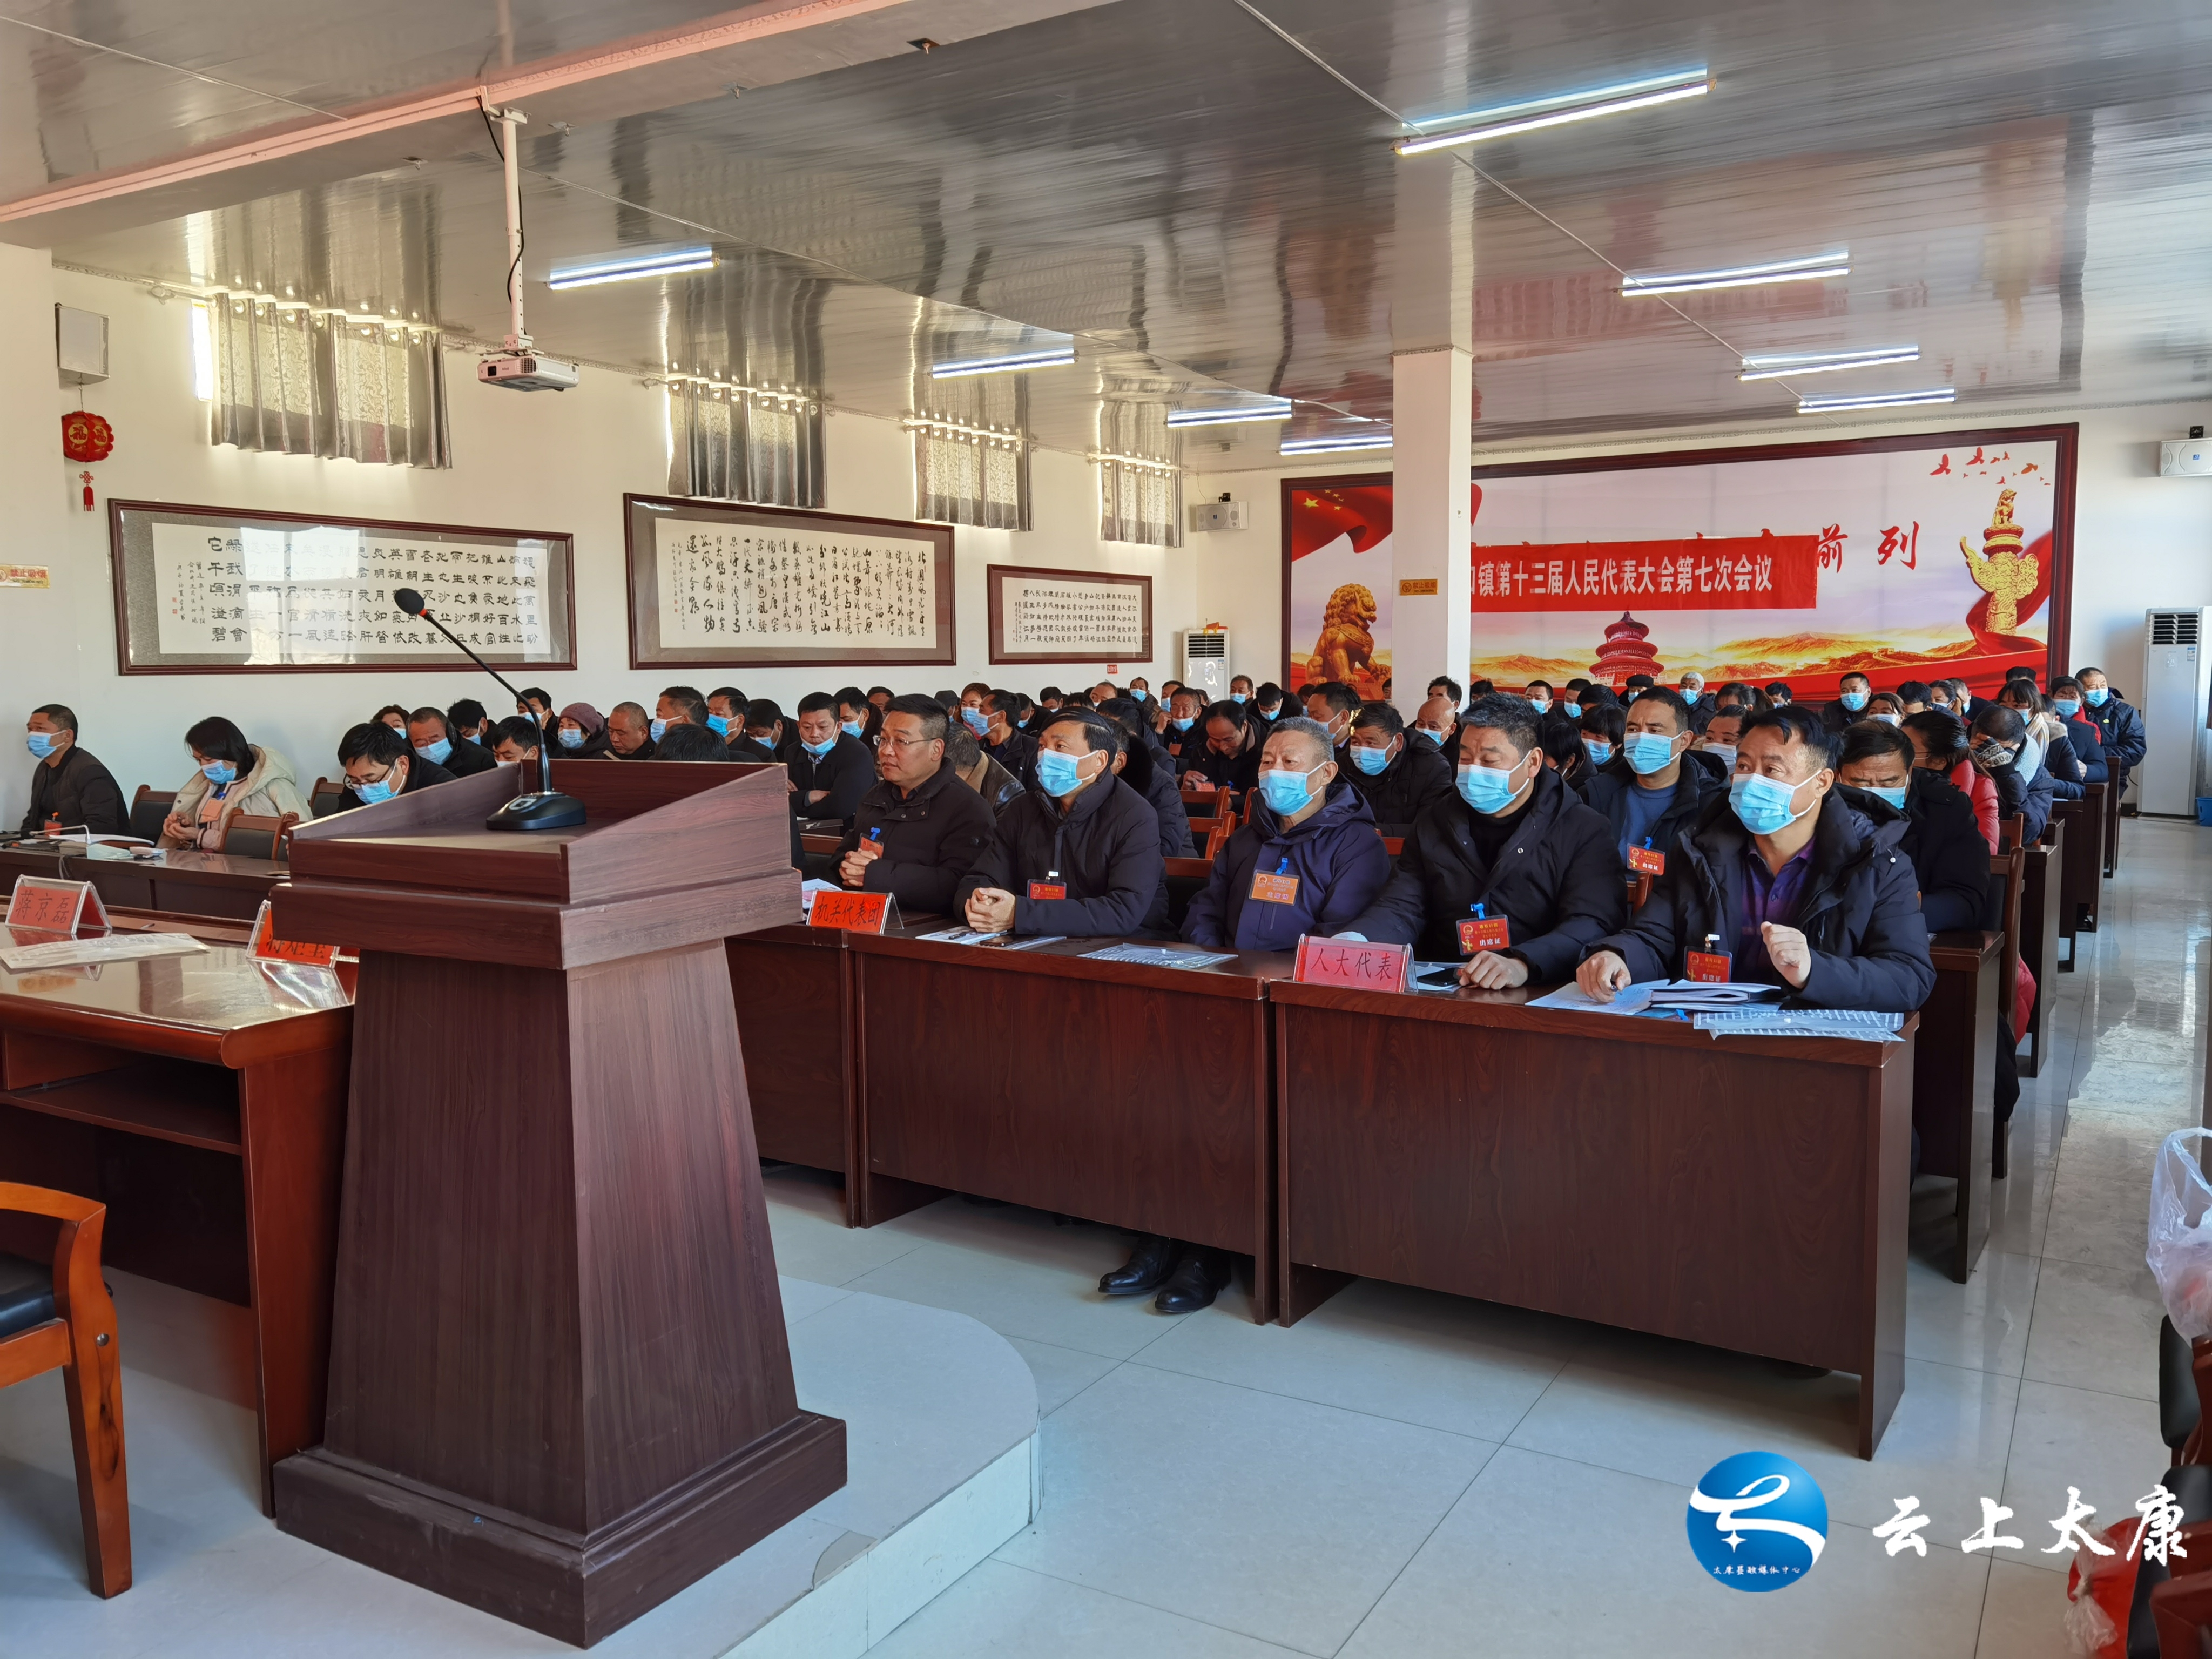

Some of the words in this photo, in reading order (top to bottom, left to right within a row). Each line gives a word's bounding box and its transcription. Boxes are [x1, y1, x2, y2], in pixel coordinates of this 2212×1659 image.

[1817, 521, 1920, 573] 前列
[815, 896, 881, 927] 机关代表团
[1310, 948, 1393, 981] 人大代表
